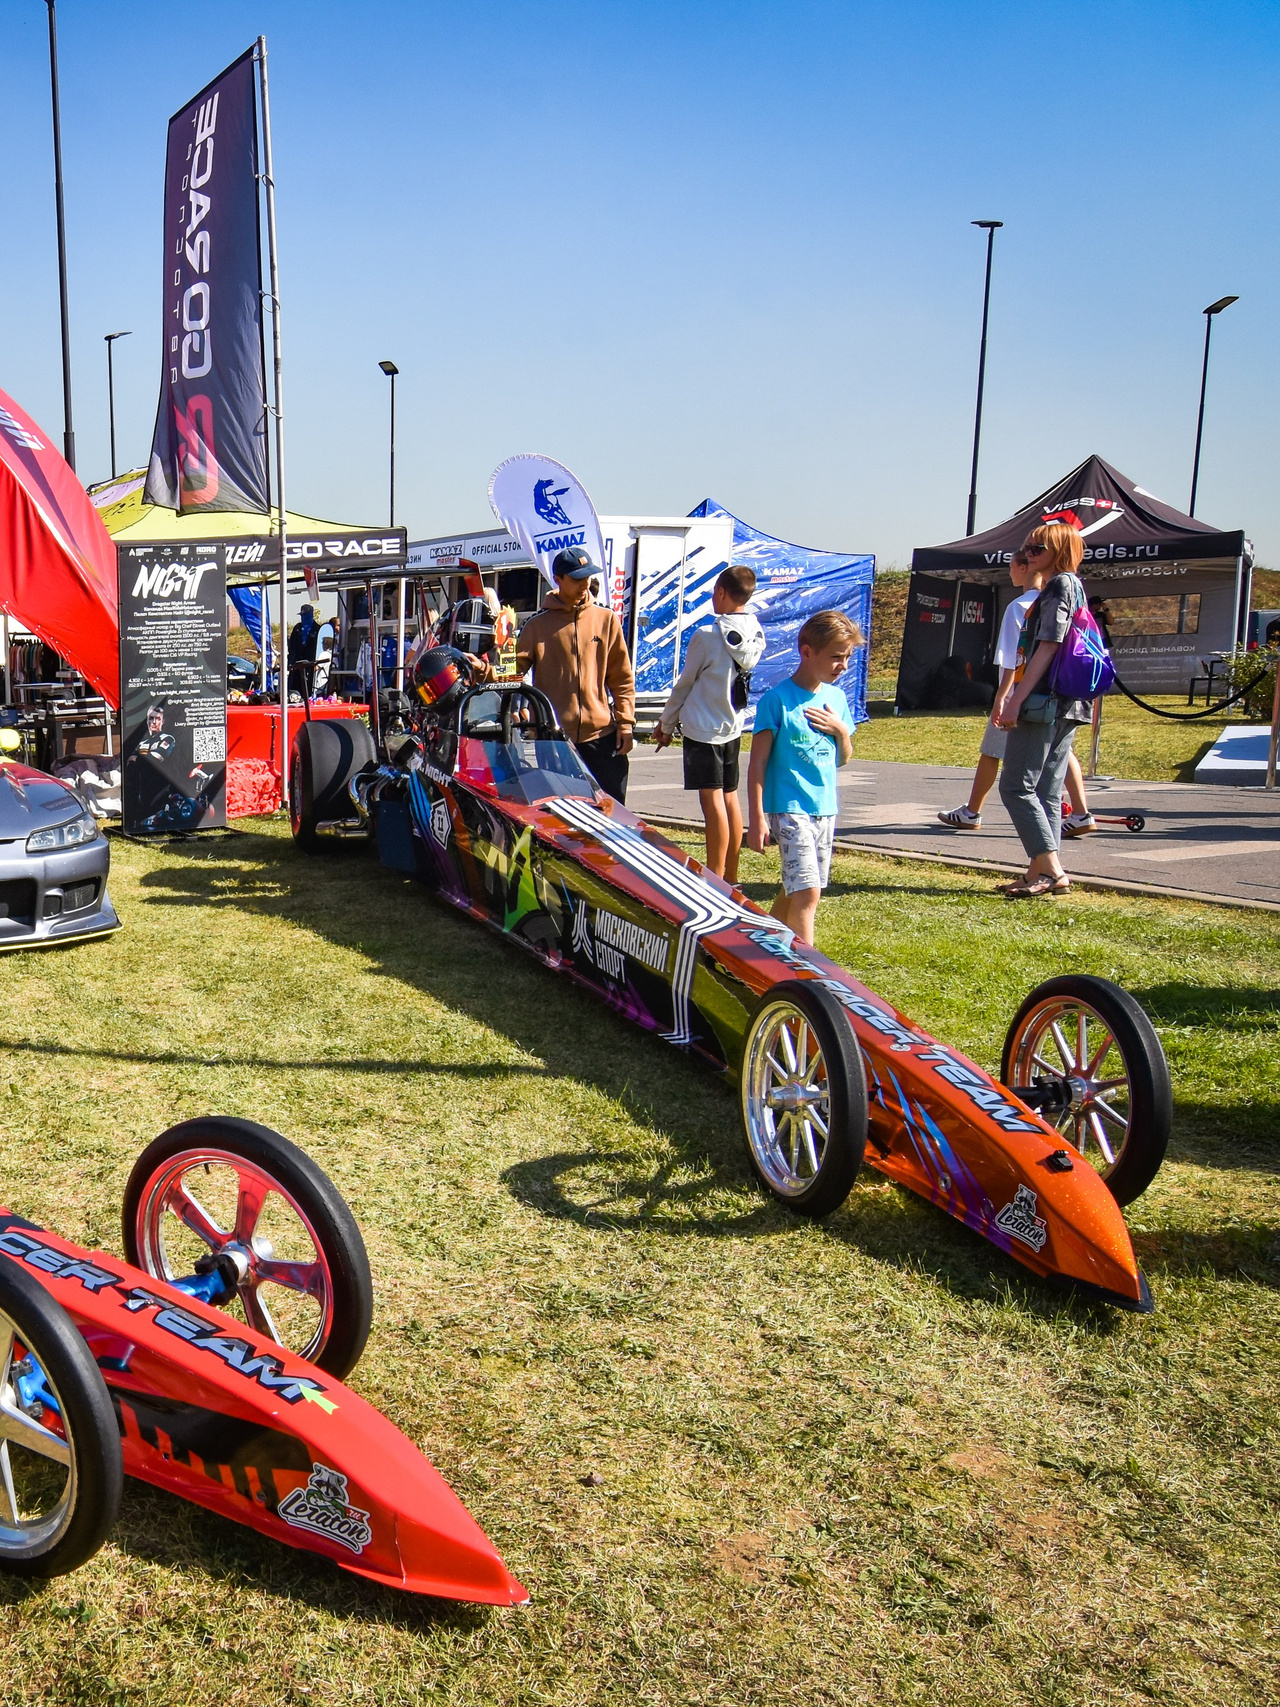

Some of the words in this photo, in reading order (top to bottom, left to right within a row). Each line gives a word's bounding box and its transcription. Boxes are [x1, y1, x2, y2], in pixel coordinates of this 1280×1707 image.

[430, 545, 463, 558] KAMAZ
[471, 545, 502, 556] OFFICIAL
[535, 532, 588, 554] KAMAZ
[131, 562, 218, 600] NIGHT
[763, 567, 805, 576] KAMAZ
[770, 575, 798, 584] master
[594, 907, 669, 974] МОСКОВСКИЙ
[594, 940, 626, 984] СПОРТ
[738, 926, 829, 977] NIGHT
[818, 978, 921, 1049] RACER
[919, 1047, 1049, 1136] TEAM
[997, 1206, 1044, 1243] Lezaton
[122, 1286, 325, 1406] TEAM
[281, 1492, 366, 1541] Lezaton
